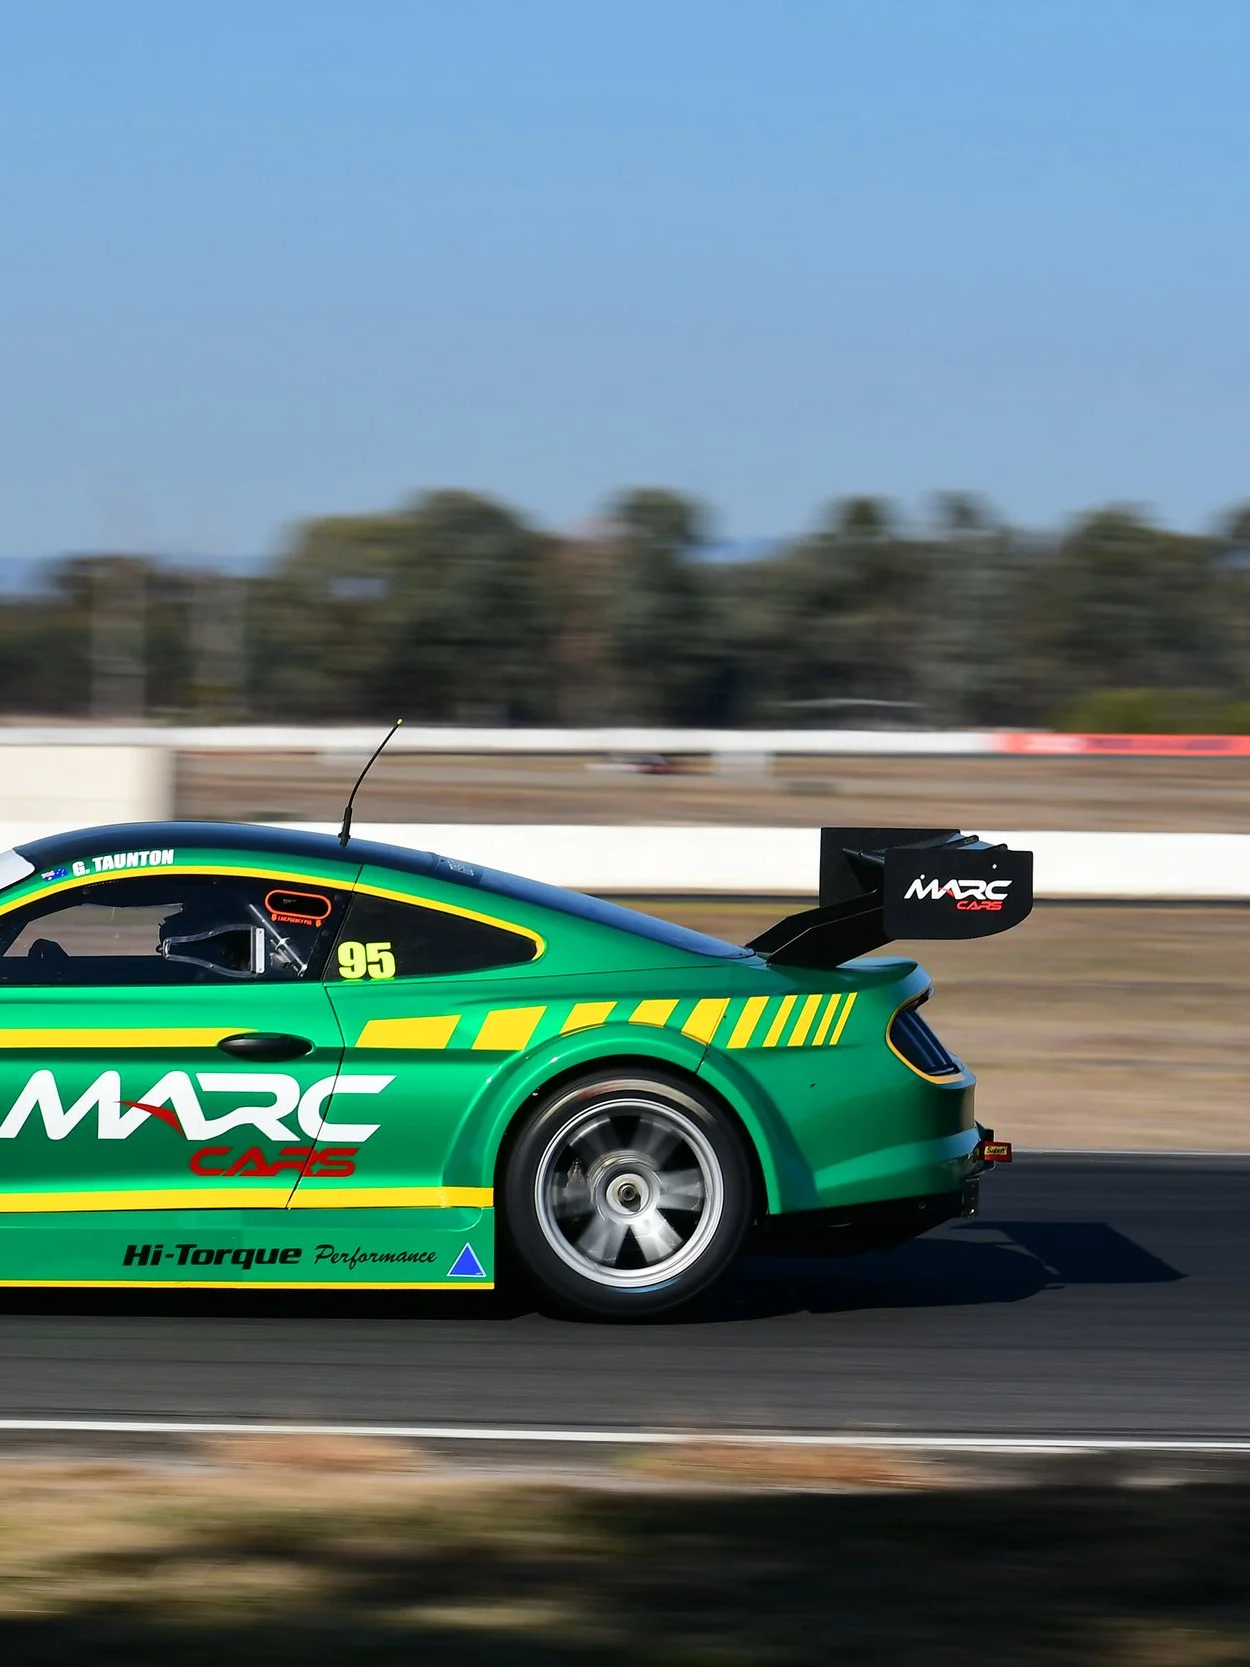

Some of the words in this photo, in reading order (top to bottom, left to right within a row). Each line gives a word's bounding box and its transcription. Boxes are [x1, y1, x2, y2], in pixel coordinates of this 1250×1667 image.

[72, 861, 90, 877] G.
[92, 849, 174, 872] TAUNTON
[903, 878, 1012, 900] MARC
[956, 900, 1003, 911] CARS
[337, 941, 396, 979] 95
[189, 1146, 360, 1178] CARS
[122, 1244, 302, 1270] Hi-Torque
[314, 1244, 438, 1271] Performance
